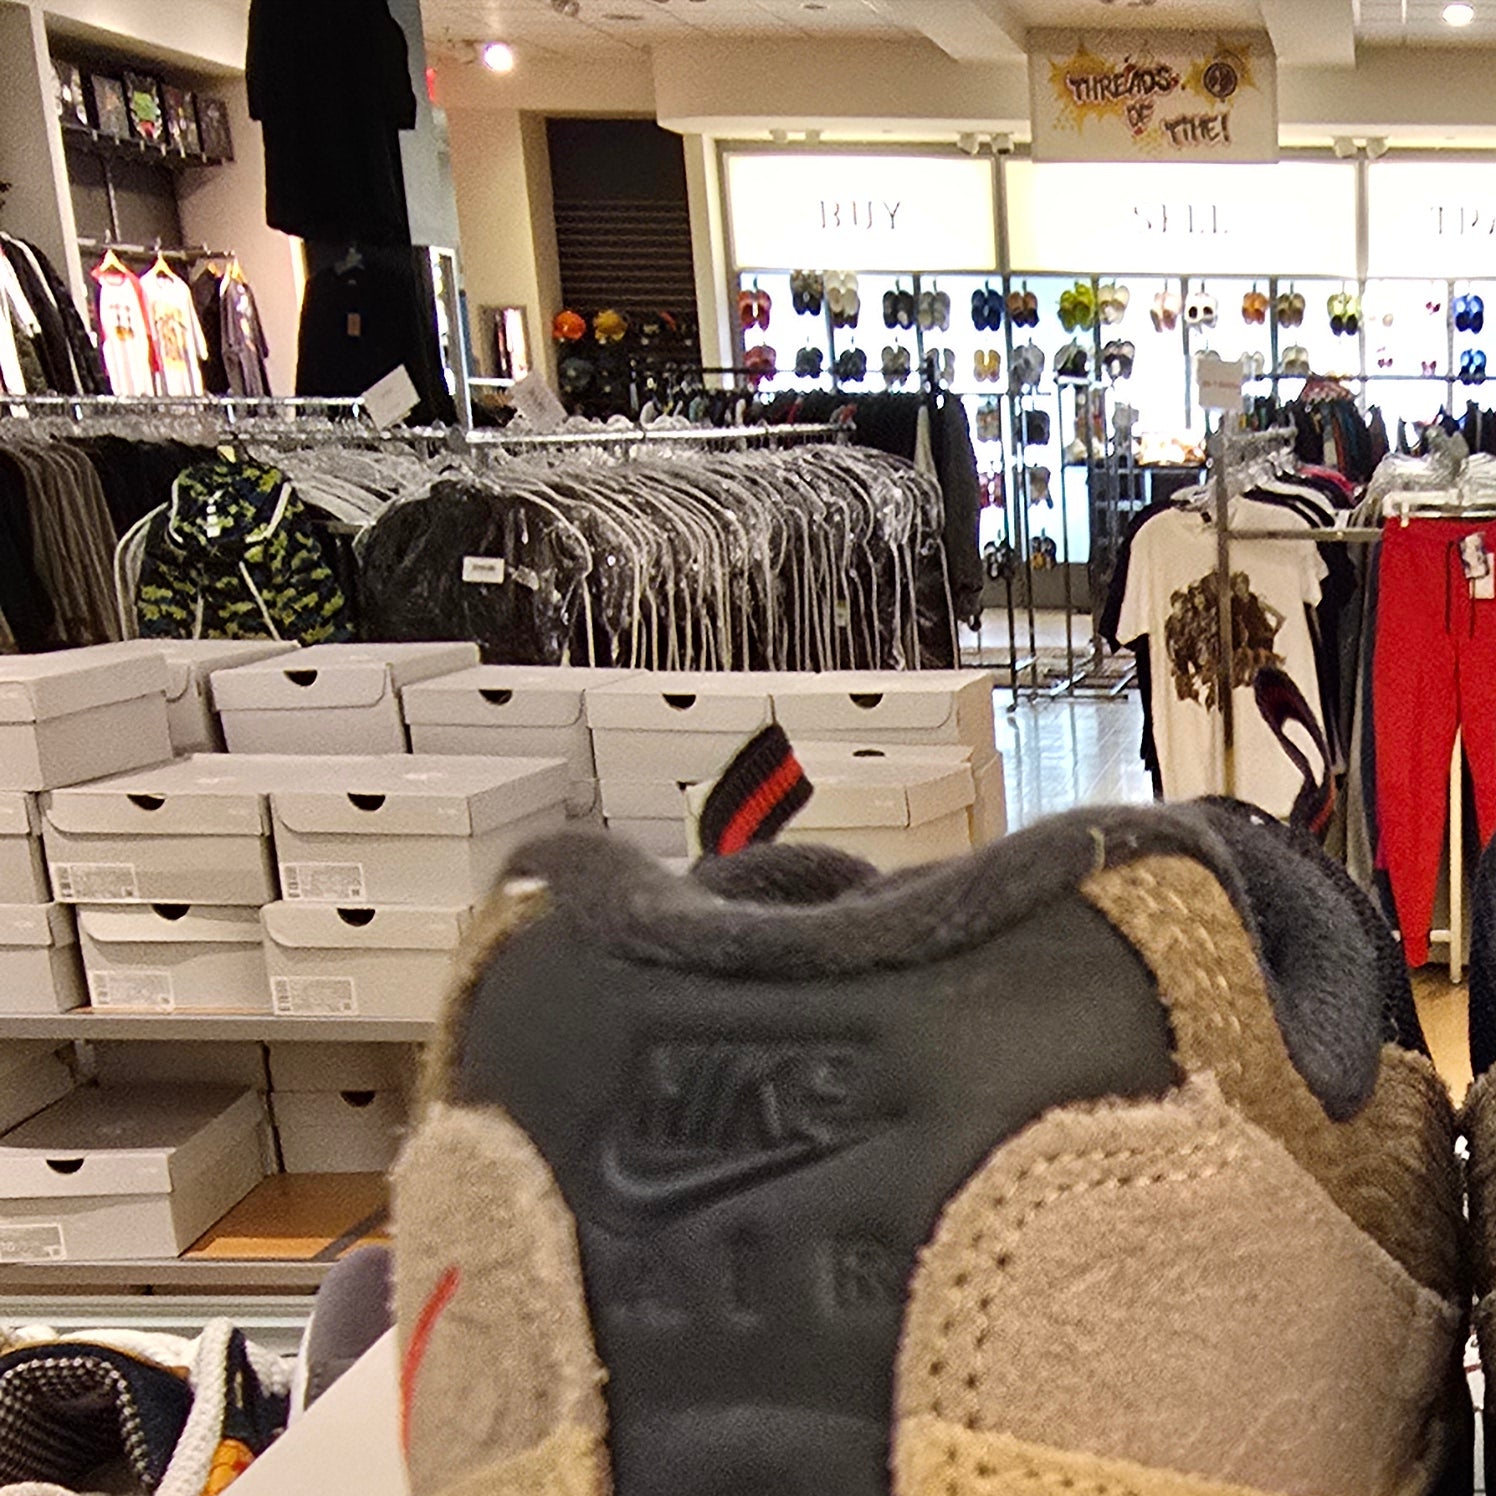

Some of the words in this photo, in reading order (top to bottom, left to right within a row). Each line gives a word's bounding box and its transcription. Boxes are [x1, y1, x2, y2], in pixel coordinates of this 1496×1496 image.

[1065, 64, 1178, 101] THREADS
[1126, 101, 1154, 129] OF
[820, 200, 900, 230] BUY
[636, 1040, 860, 1148] NIKE
